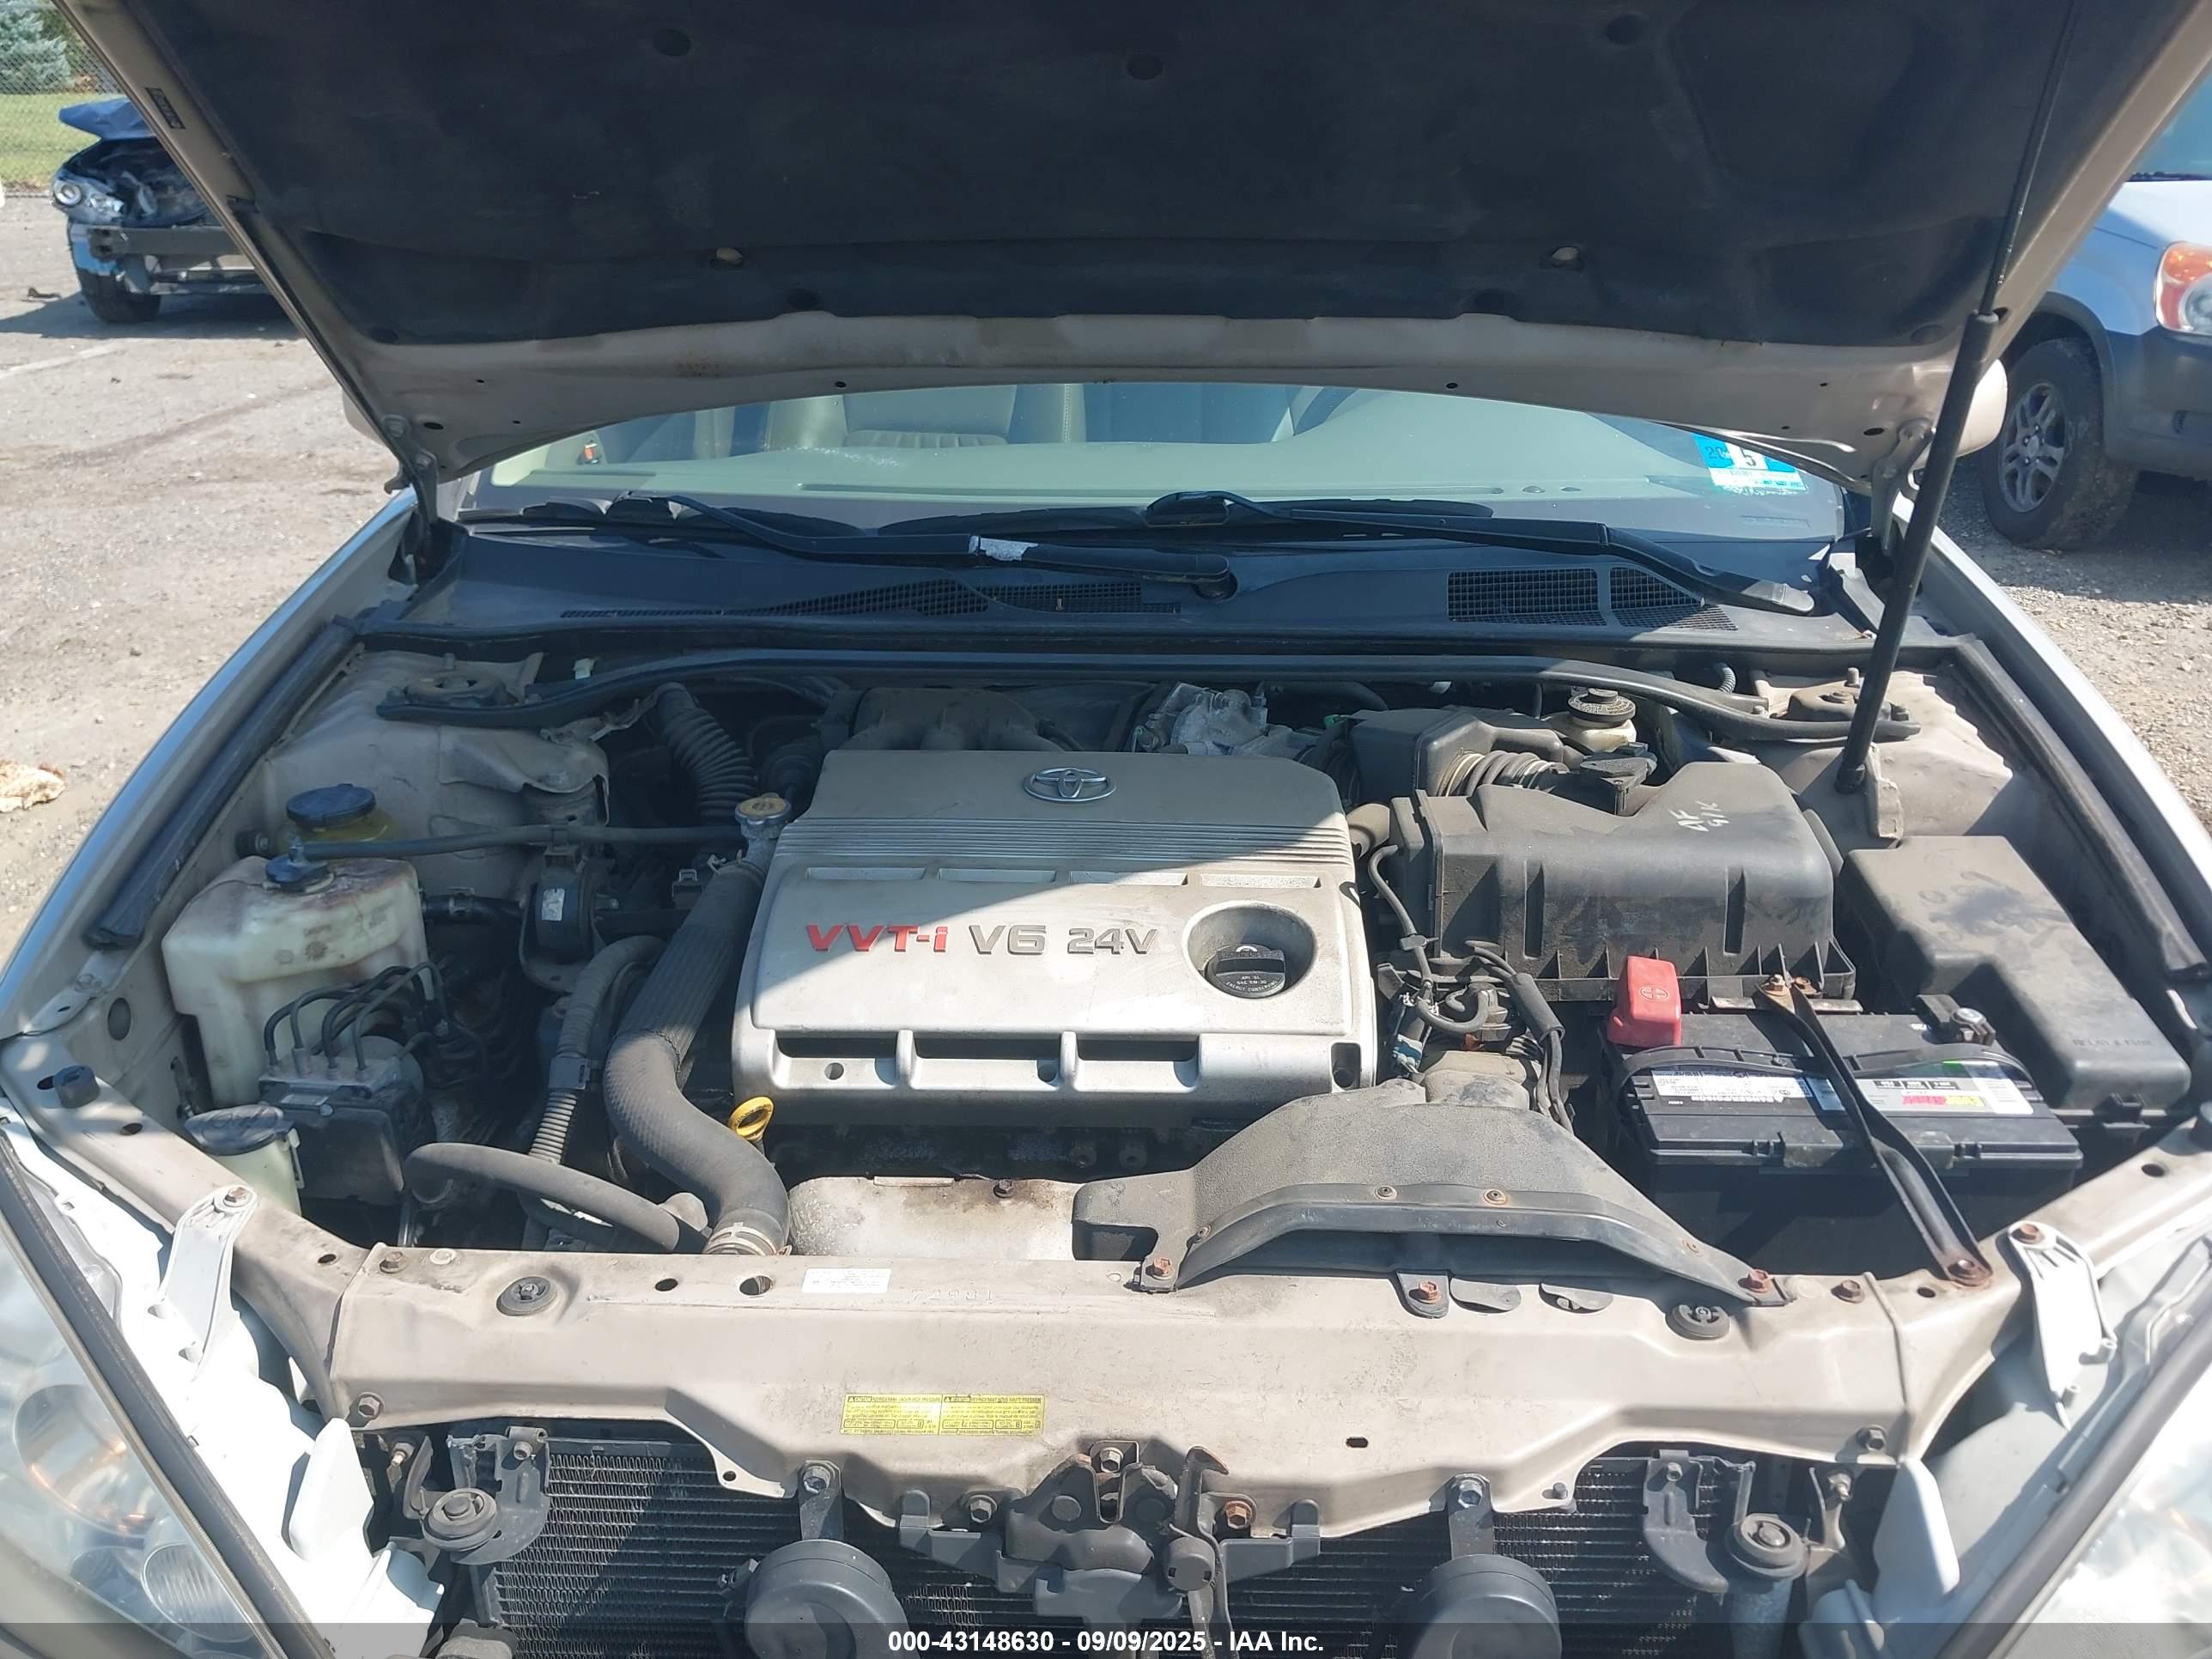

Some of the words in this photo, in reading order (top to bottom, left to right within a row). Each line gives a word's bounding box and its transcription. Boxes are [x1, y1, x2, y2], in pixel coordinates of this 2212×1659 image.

[806, 924, 948, 952] VVT-i
[969, 925, 1047, 955] V6
[1067, 927, 1158, 955] 24V
[1225, 981, 1246, 991] ENERGY
